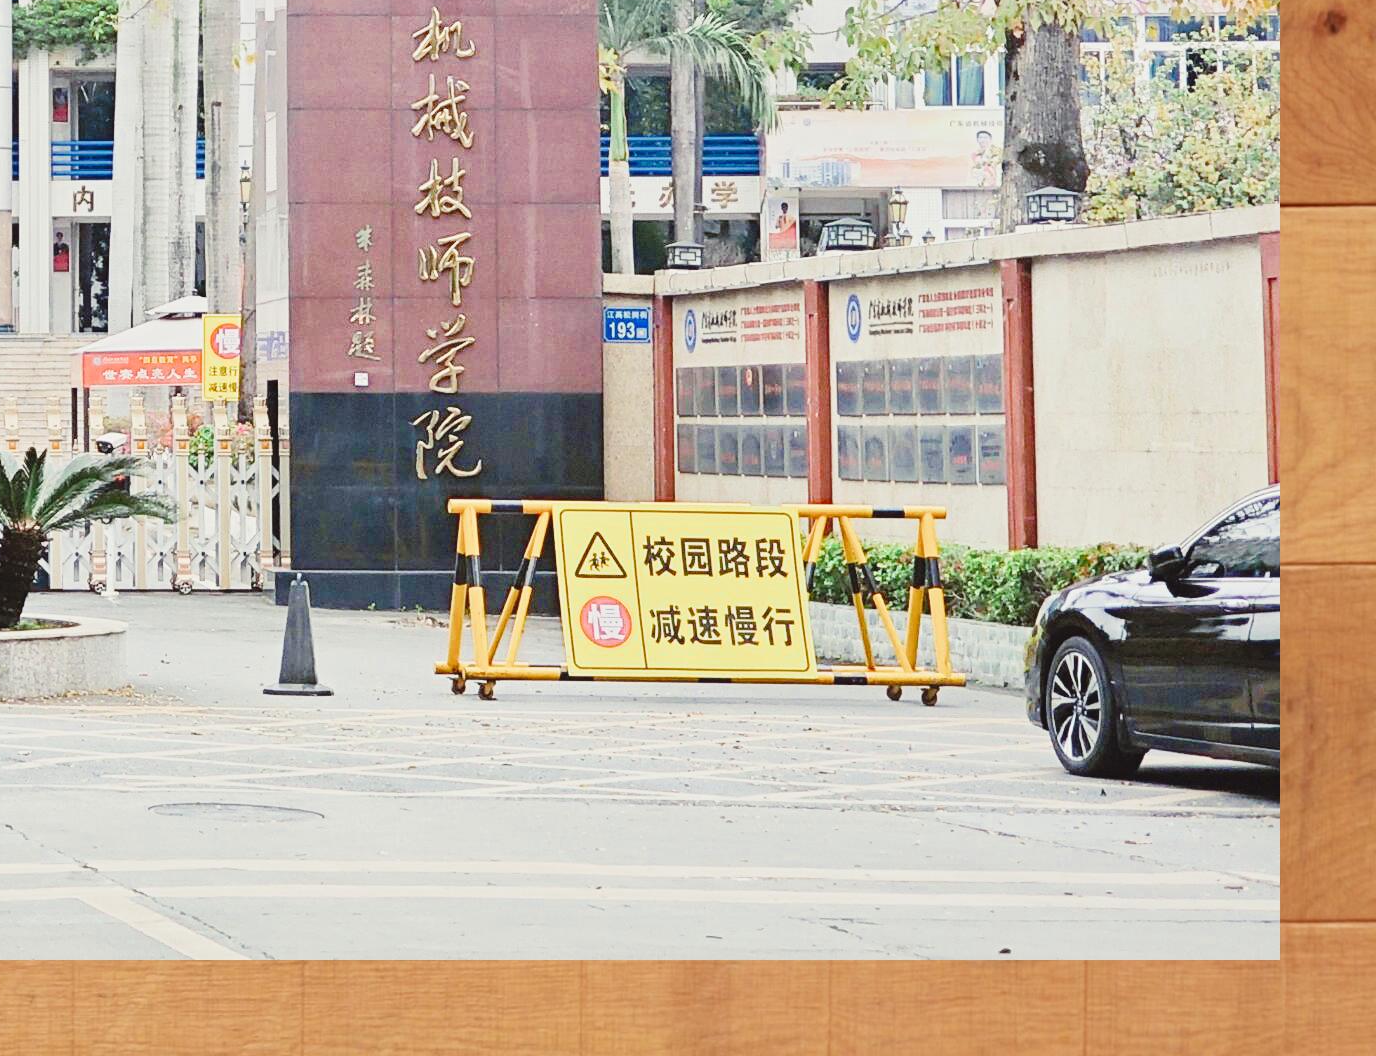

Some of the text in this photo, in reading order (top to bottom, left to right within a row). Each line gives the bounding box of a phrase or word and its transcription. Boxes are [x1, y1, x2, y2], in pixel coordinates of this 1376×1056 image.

[72, 184, 95, 214] 内
[608, 321, 636, 339] 193
[102, 367, 198, 381] 世赛点亮人生
[643, 535, 789, 579] 校园路段
[587, 602, 626, 642] 慢
[649, 604, 795, 647] 减速慢行
